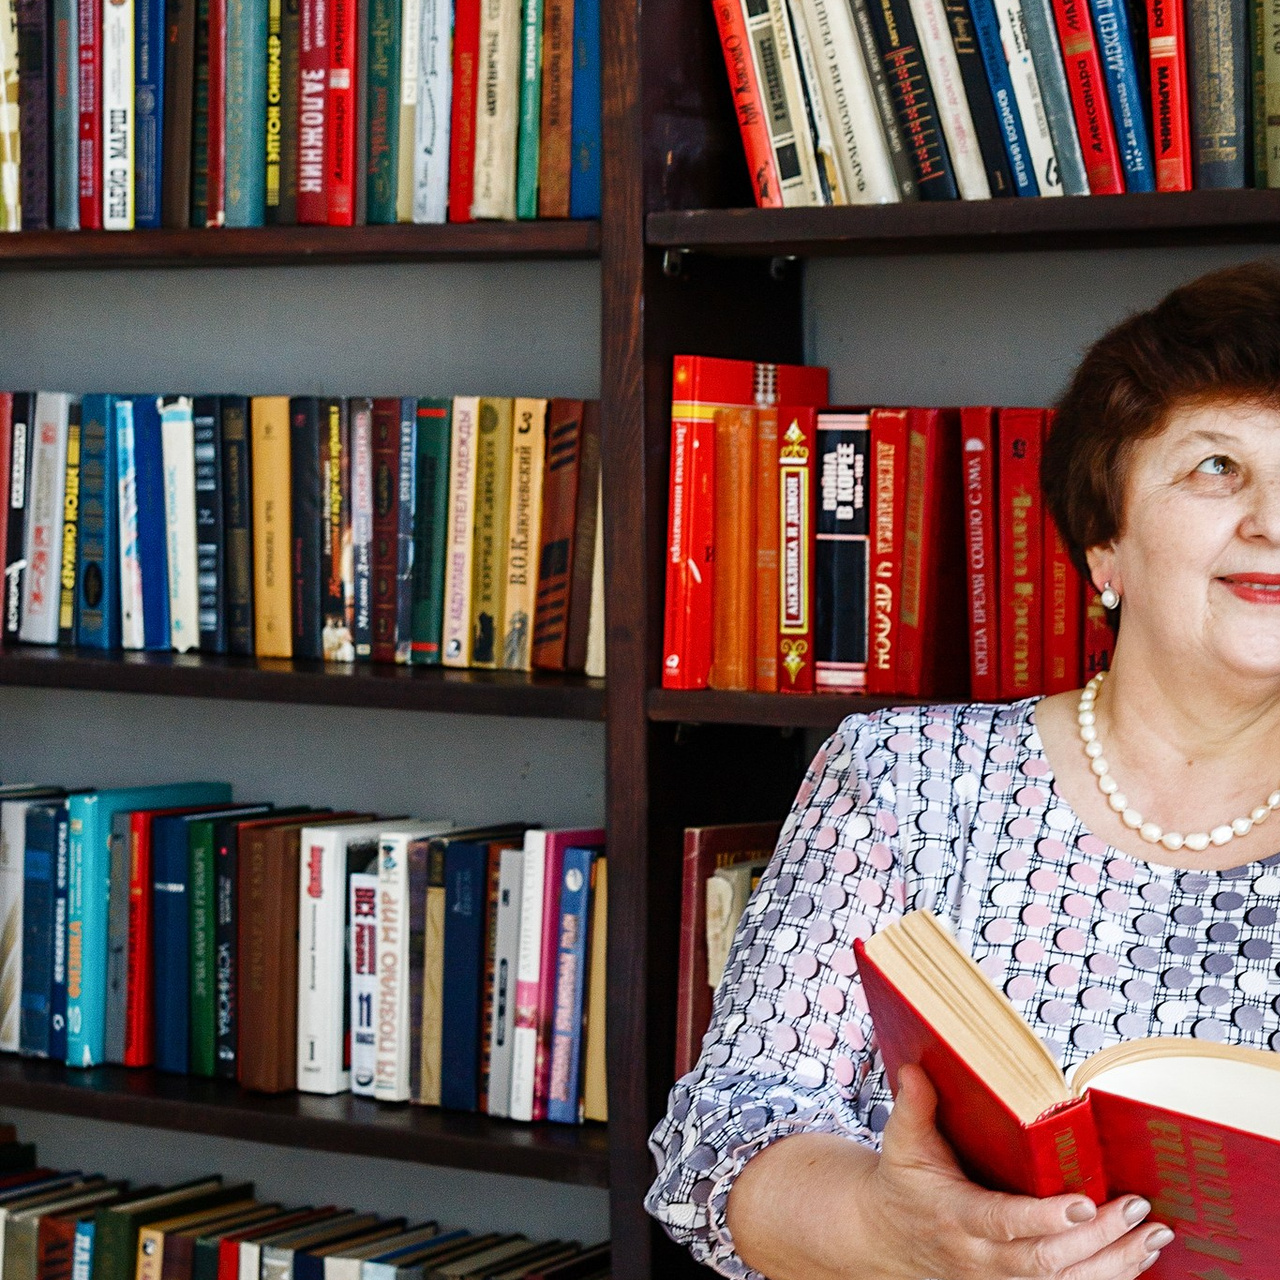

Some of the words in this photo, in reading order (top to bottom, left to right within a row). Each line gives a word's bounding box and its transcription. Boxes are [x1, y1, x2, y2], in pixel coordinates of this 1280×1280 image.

[268, 35, 282, 104] СИНКЛЕР
[825, 50, 836, 60] С
[267, 106, 281, 162] ЭПТОН
[828, 63, 866, 193] ФАРМАКОЛОГИЯ
[1075, 58, 1103, 154] Александра
[455, 410, 471, 491] НАДЕЖДЫ
[837, 442, 854, 503] КОРЕЕ
[967, 457, 983, 490] УМА
[822, 451, 838, 512] ВОЙНА
[453, 494, 467, 546] ПЕПЕЛ
[839, 506, 854, 520] В
[969, 508, 984, 570] СОШЛО
[971, 573, 986, 624] ВРЕМЯ
[974, 627, 989, 676] КОГДА
[379, 889, 397, 944] МИР
[67, 920, 82, 999] ФИЗИКА
[379, 952, 397, 1054] ПОЗНАЮ
